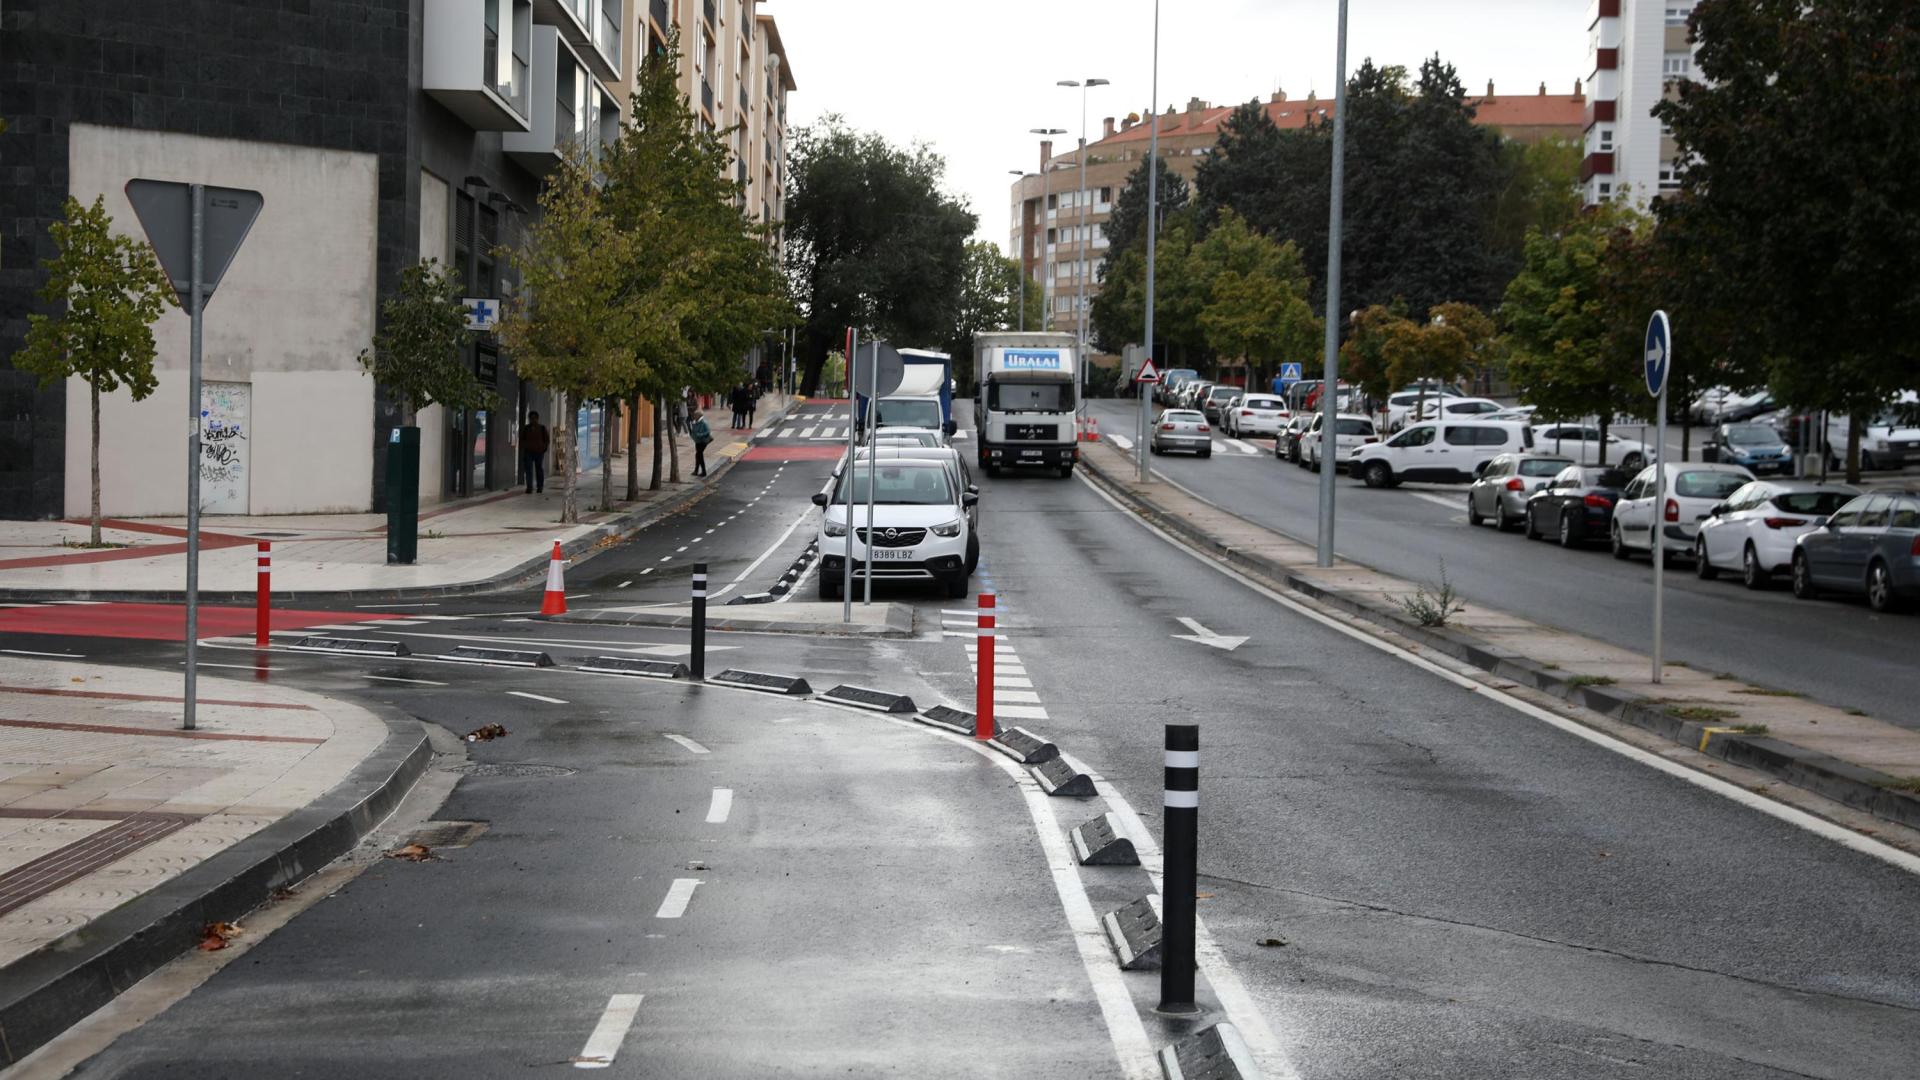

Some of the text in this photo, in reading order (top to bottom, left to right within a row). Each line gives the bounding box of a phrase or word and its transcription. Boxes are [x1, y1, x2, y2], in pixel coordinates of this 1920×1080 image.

[393, 429, 400, 441] P
[874, 551, 912, 559] 8389 LBZ
